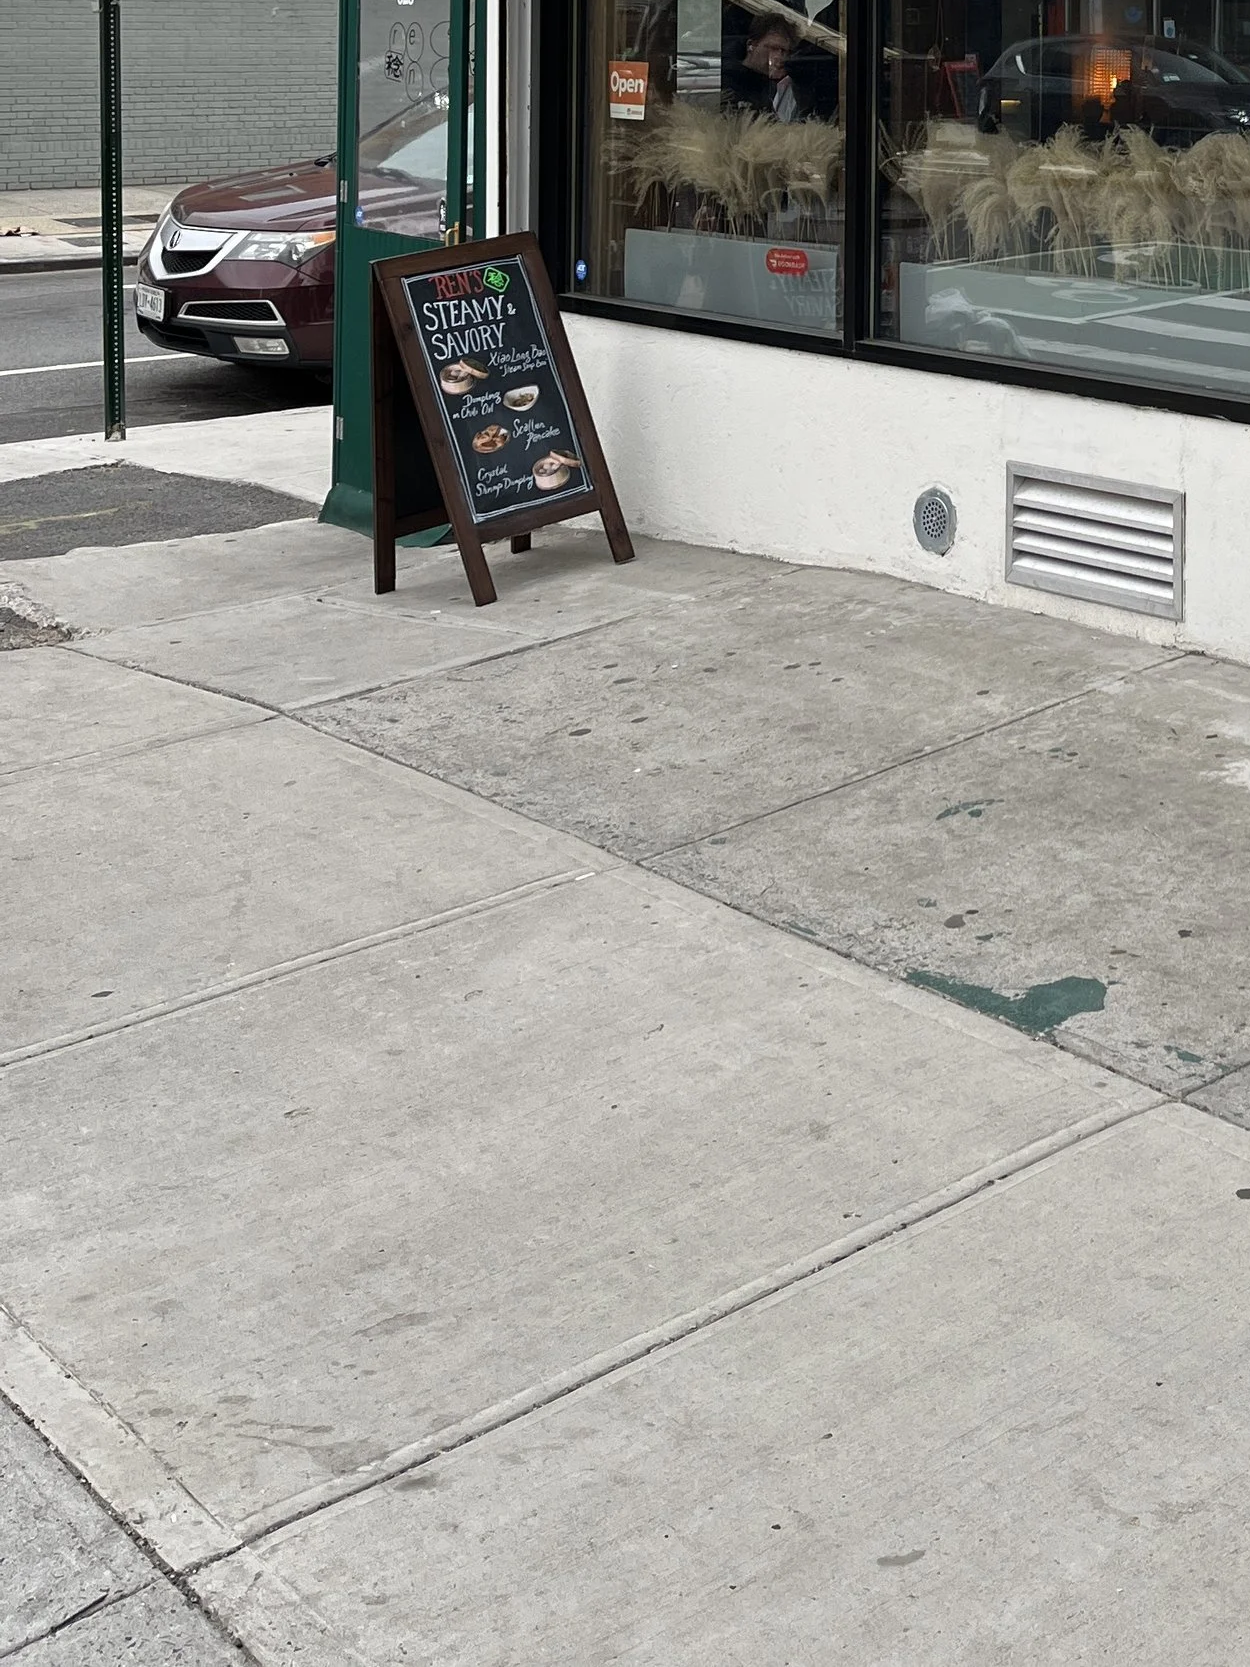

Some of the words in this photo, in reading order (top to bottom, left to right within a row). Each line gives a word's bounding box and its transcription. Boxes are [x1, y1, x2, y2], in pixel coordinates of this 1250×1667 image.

[610, 71, 645, 98] Open
[428, 270, 485, 300] REN'S
[423, 295, 505, 331] STEAMY
[507, 303, 516, 315] &
[431, 322, 506, 360] SAVORY
